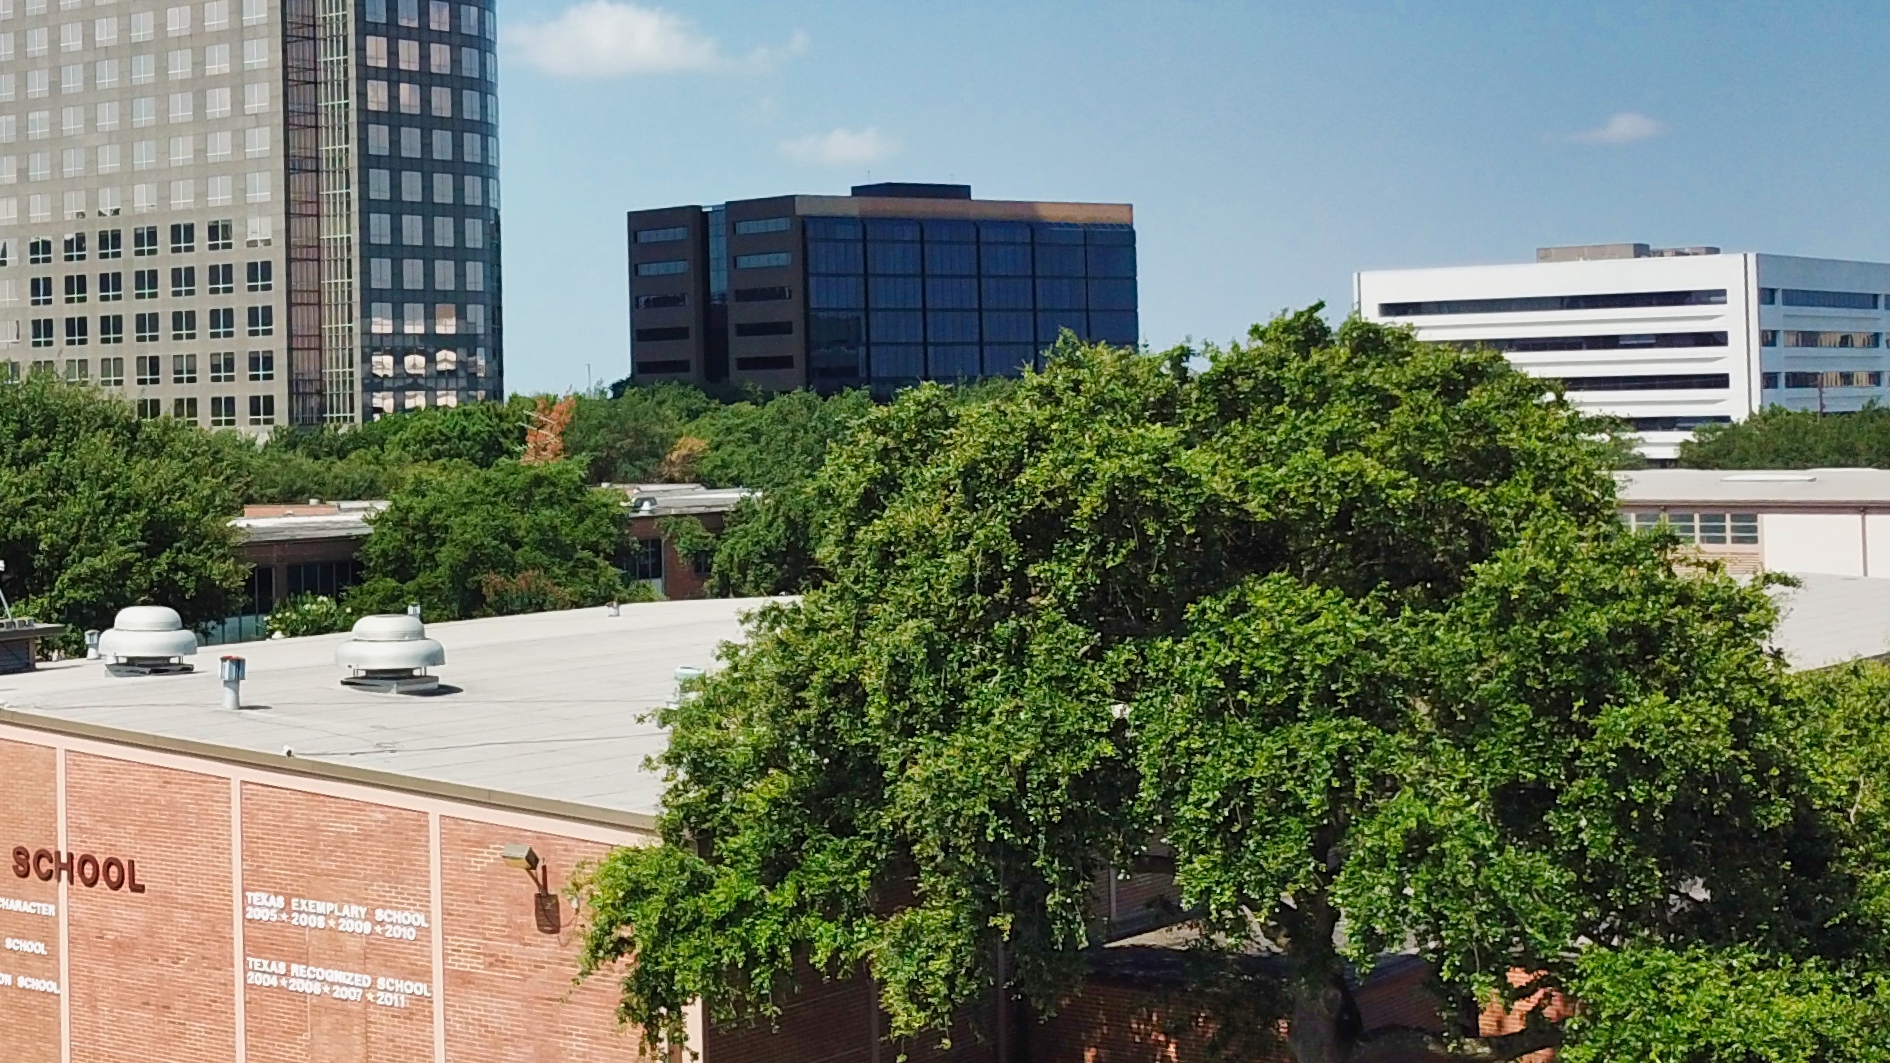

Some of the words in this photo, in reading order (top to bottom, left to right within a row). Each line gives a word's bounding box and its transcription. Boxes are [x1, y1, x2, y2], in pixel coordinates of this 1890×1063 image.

[11, 845, 146, 893] SCHOOL
[245, 891, 285, 909] TEXAS
[291, 898, 368, 919] EXEMPLARY
[374, 908, 430, 928] SCHOOL
[245, 906, 278, 922] 2005
[384, 924, 417, 941] 2010
[5, 937, 47, 955] SCHOOL
[17, 975, 61, 994] SCHOOL
[246, 957, 286, 975] TEXAS
[291, 963, 372, 988] RECOGNIZED
[377, 976, 432, 997] SCHOOL
[246, 971, 278, 988] 2004
[288, 978, 321, 996] 2006
[332, 985, 364, 1002] 2007
[376, 991, 406, 1009] 2011
